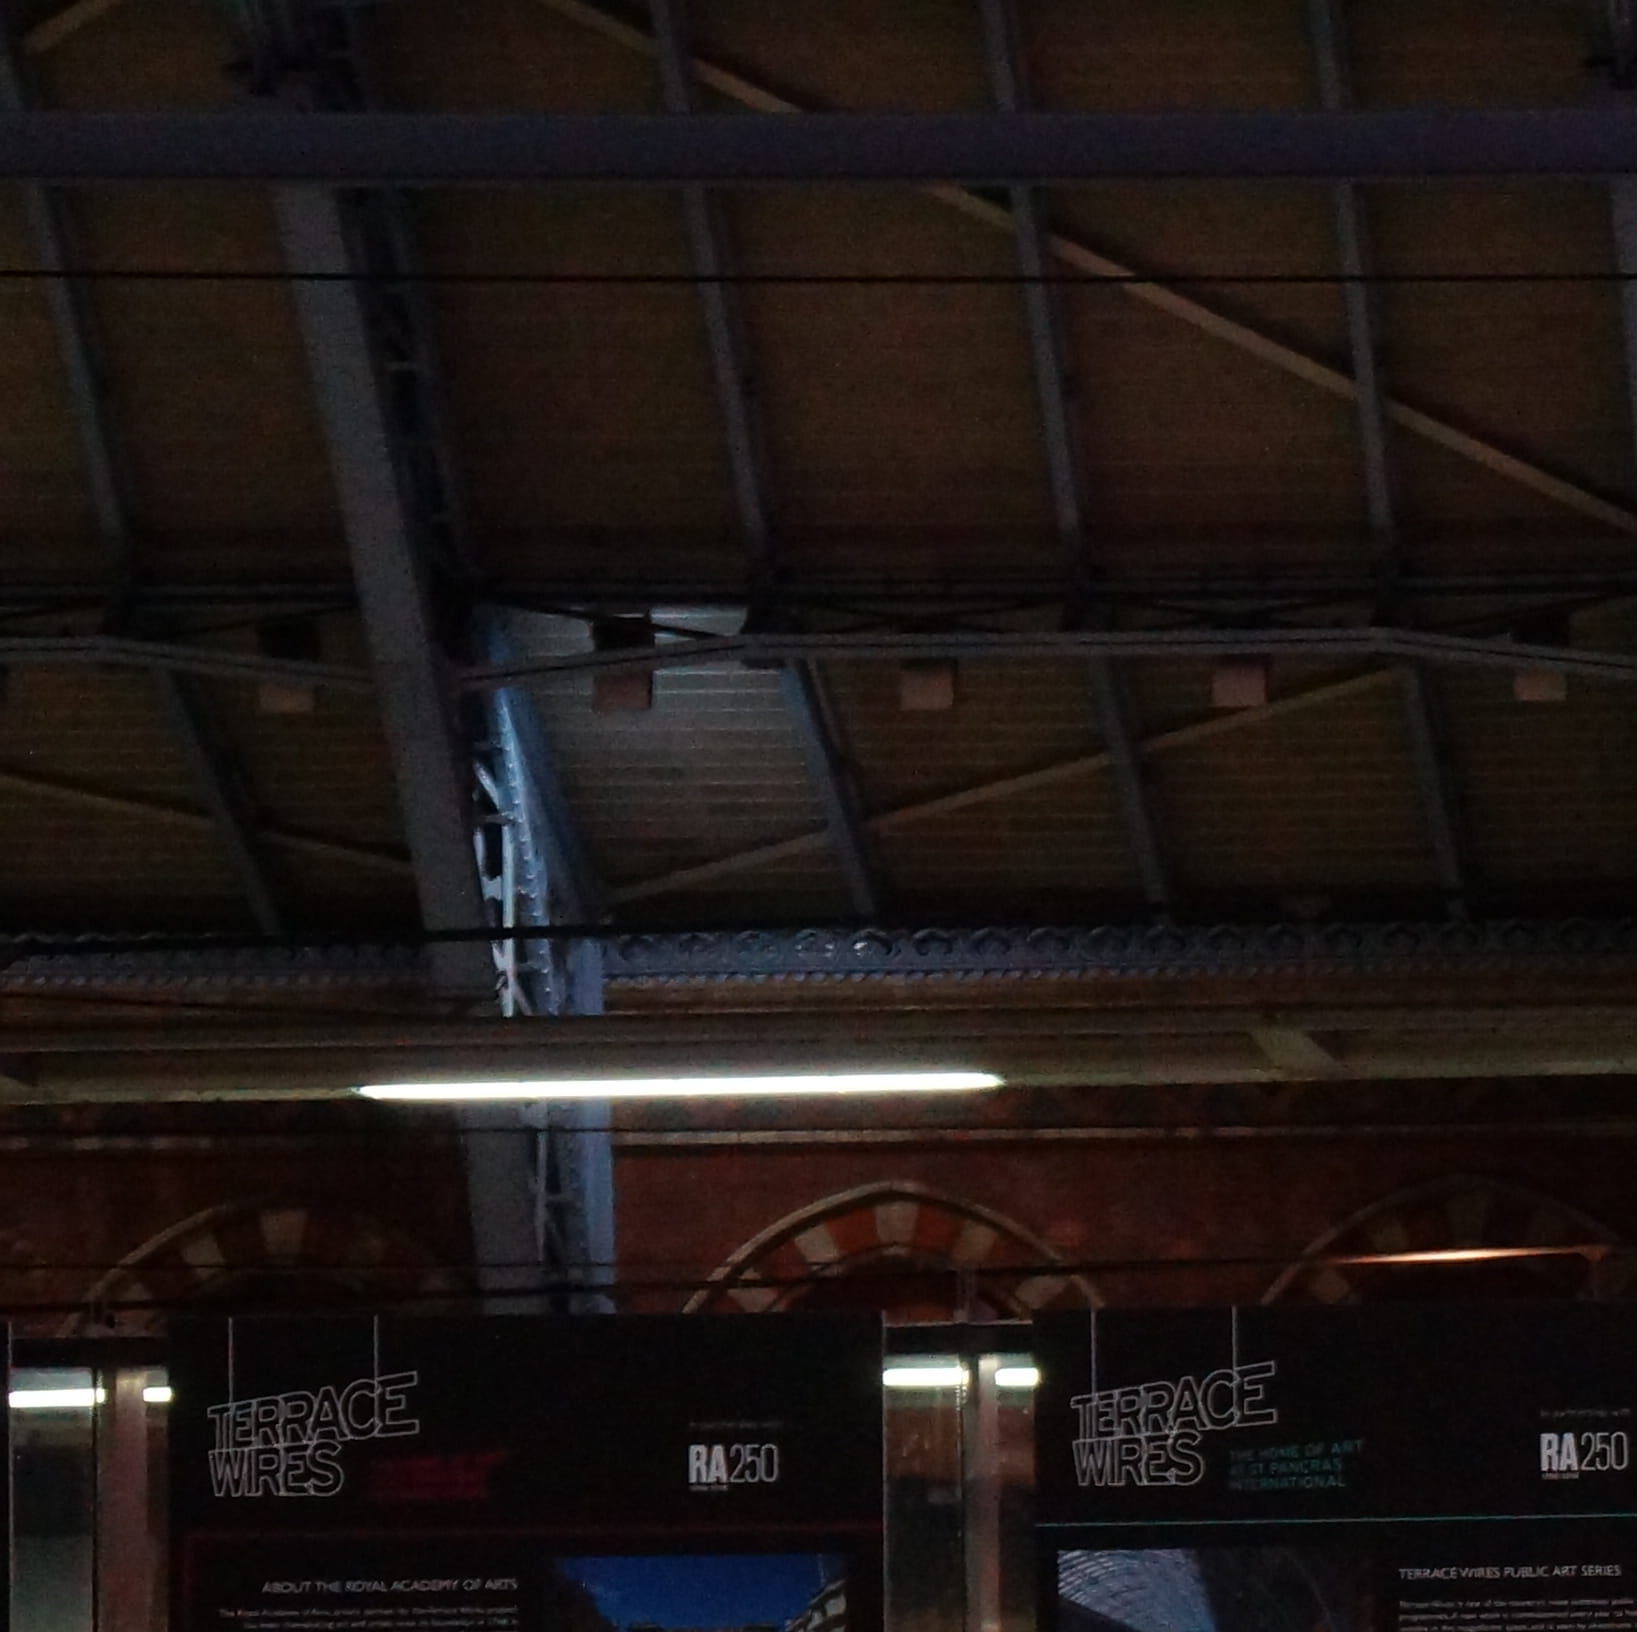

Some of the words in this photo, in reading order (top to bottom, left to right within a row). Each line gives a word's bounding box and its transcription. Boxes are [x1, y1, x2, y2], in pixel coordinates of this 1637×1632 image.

[207, 1371, 420, 1451] TERRACE
[1070, 1361, 1277, 1440] TERRACE
[208, 1440, 344, 1497] WIRES
[688, 1442, 779, 1484] RA250
[1072, 1430, 1205, 1487] WIRES
[1539, 1430, 1629, 1472] RA250
[262, 1580, 312, 1594] ABOUT
[315, 1580, 342, 1594] THE
[345, 1580, 388, 1593] ROYAL
[391, 1578, 459, 1592] ACADEMY
[485, 1577, 519, 1591] ARTS
[1398, 1567, 1458, 1580] TERRACE
[1459, 1566, 1501, 1579] WIRES
[1503, 1566, 1549, 1578] PUBLIC
[1552, 1565, 1578, 1577] ART
[1581, 1564, 1622, 1577] SERIES
